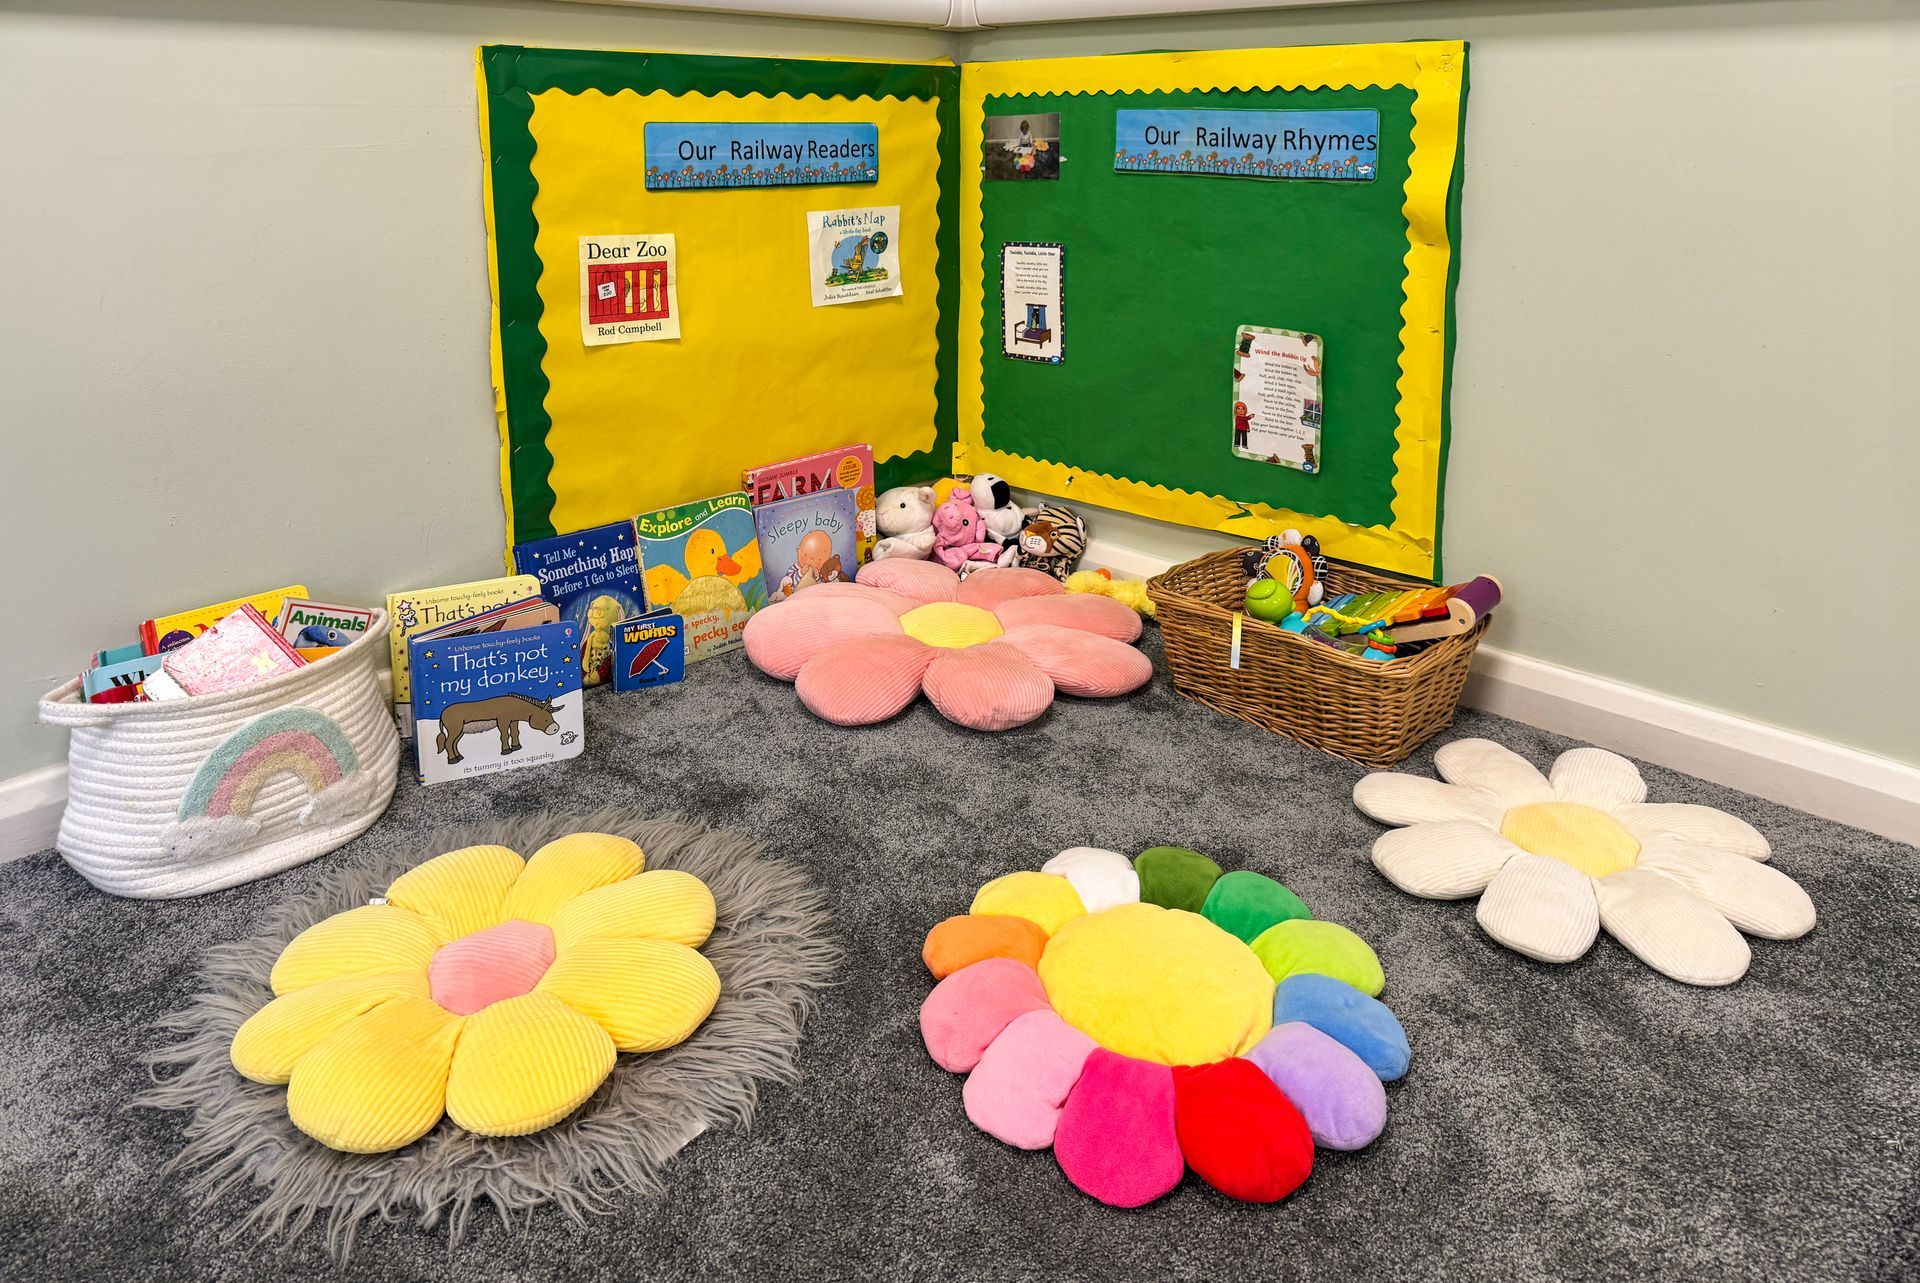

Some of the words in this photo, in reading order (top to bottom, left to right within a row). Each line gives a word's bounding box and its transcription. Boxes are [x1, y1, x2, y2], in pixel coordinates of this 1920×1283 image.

[678, 141, 716, 160] Our
[731, 139, 803, 163] Railway
[808, 139, 875, 158] Readers
[1145, 126, 1180, 145] Our
[1197, 127, 1277, 154] Railway
[1284, 128, 1377, 155] Rhymes
[823, 214, 861, 228] Rabbit's
[864, 212, 885, 226] Nap
[587, 243, 630, 259] Dear
[637, 241, 666, 257] Zoo
[598, 326, 615, 336] Rod
[618, 322, 662, 334] Campbell
[1282, 352, 1299, 360] Bobbin
[779, 469, 798, 478] JUMBLE
[758, 468, 832, 504] FARM
[640, 516, 692, 537] Explore
[695, 508, 708, 521] and
[708, 496, 746, 512] Learn
[768, 518, 808, 544] Sleepy
[815, 510, 844, 534] baby
[543, 551, 561, 565] Tell
[562, 547, 576, 560] Me
[538, 552, 607, 584] Something
[552, 580, 582, 597] Before
[584, 576, 590, 588] I
[591, 573, 604, 585] Go
[606, 571, 614, 580] to
[425, 597, 449, 605] Usborne
[289, 610, 365, 632] Animals
[420, 603, 475, 624] That's
[691, 615, 719, 629] specky,
[624, 625, 676, 643] WORDS
[693, 626, 728, 649] pecky
[454, 644, 480, 652] Usborne
[482, 638, 520, 648] touchy-feely
[448, 651, 507, 671] That's
[515, 644, 548, 662] not
[440, 678, 471, 695] my
[478, 665, 564, 688] donkey...
[474, 763, 501, 772] tummy
